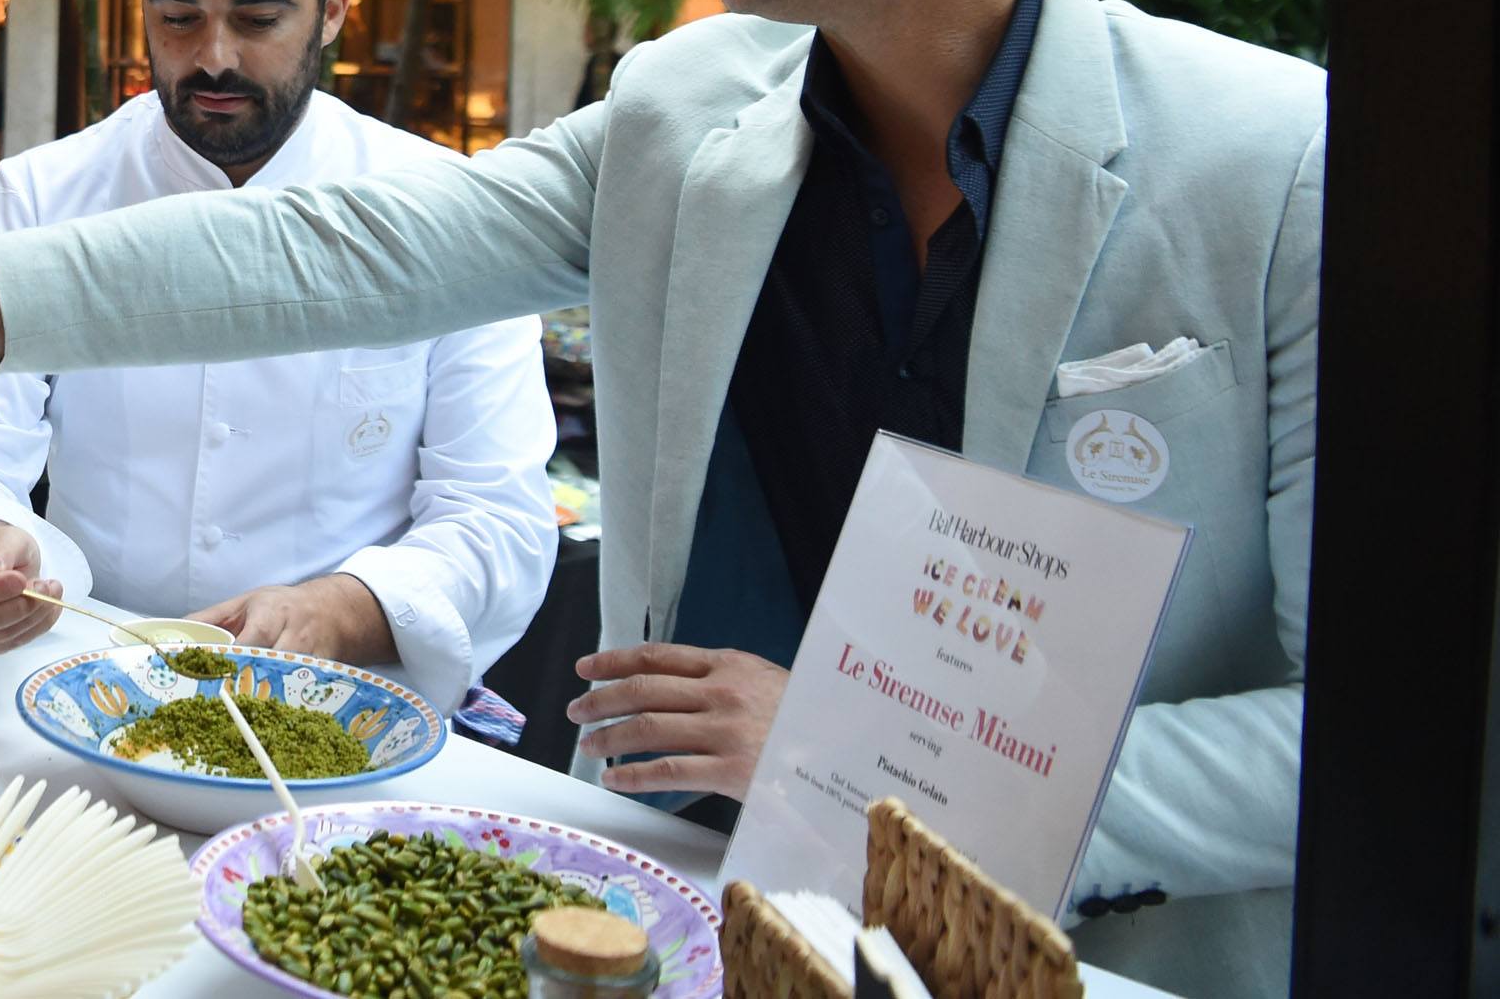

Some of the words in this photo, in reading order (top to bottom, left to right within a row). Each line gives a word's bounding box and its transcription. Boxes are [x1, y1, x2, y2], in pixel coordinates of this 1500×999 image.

[928, 508, 955, 538] Bal
[951, 517, 1020, 561] Harbour
[1017, 540, 1071, 580] Shops
[923, 553, 959, 587] ICE
[962, 573, 1046, 623] CREAM
[913, 587, 953, 627] WE
[955, 605, 1029, 665] LOVE
[936, 646, 974, 673] features
[837, 642, 865, 681] Le
[868, 659, 965, 732] Sirenuse
[968, 706, 1057, 778] Miami
[909, 731, 943, 758] serving
[877, 754, 918, 788] Pistachio
[917, 778, 949, 807] Gelato
